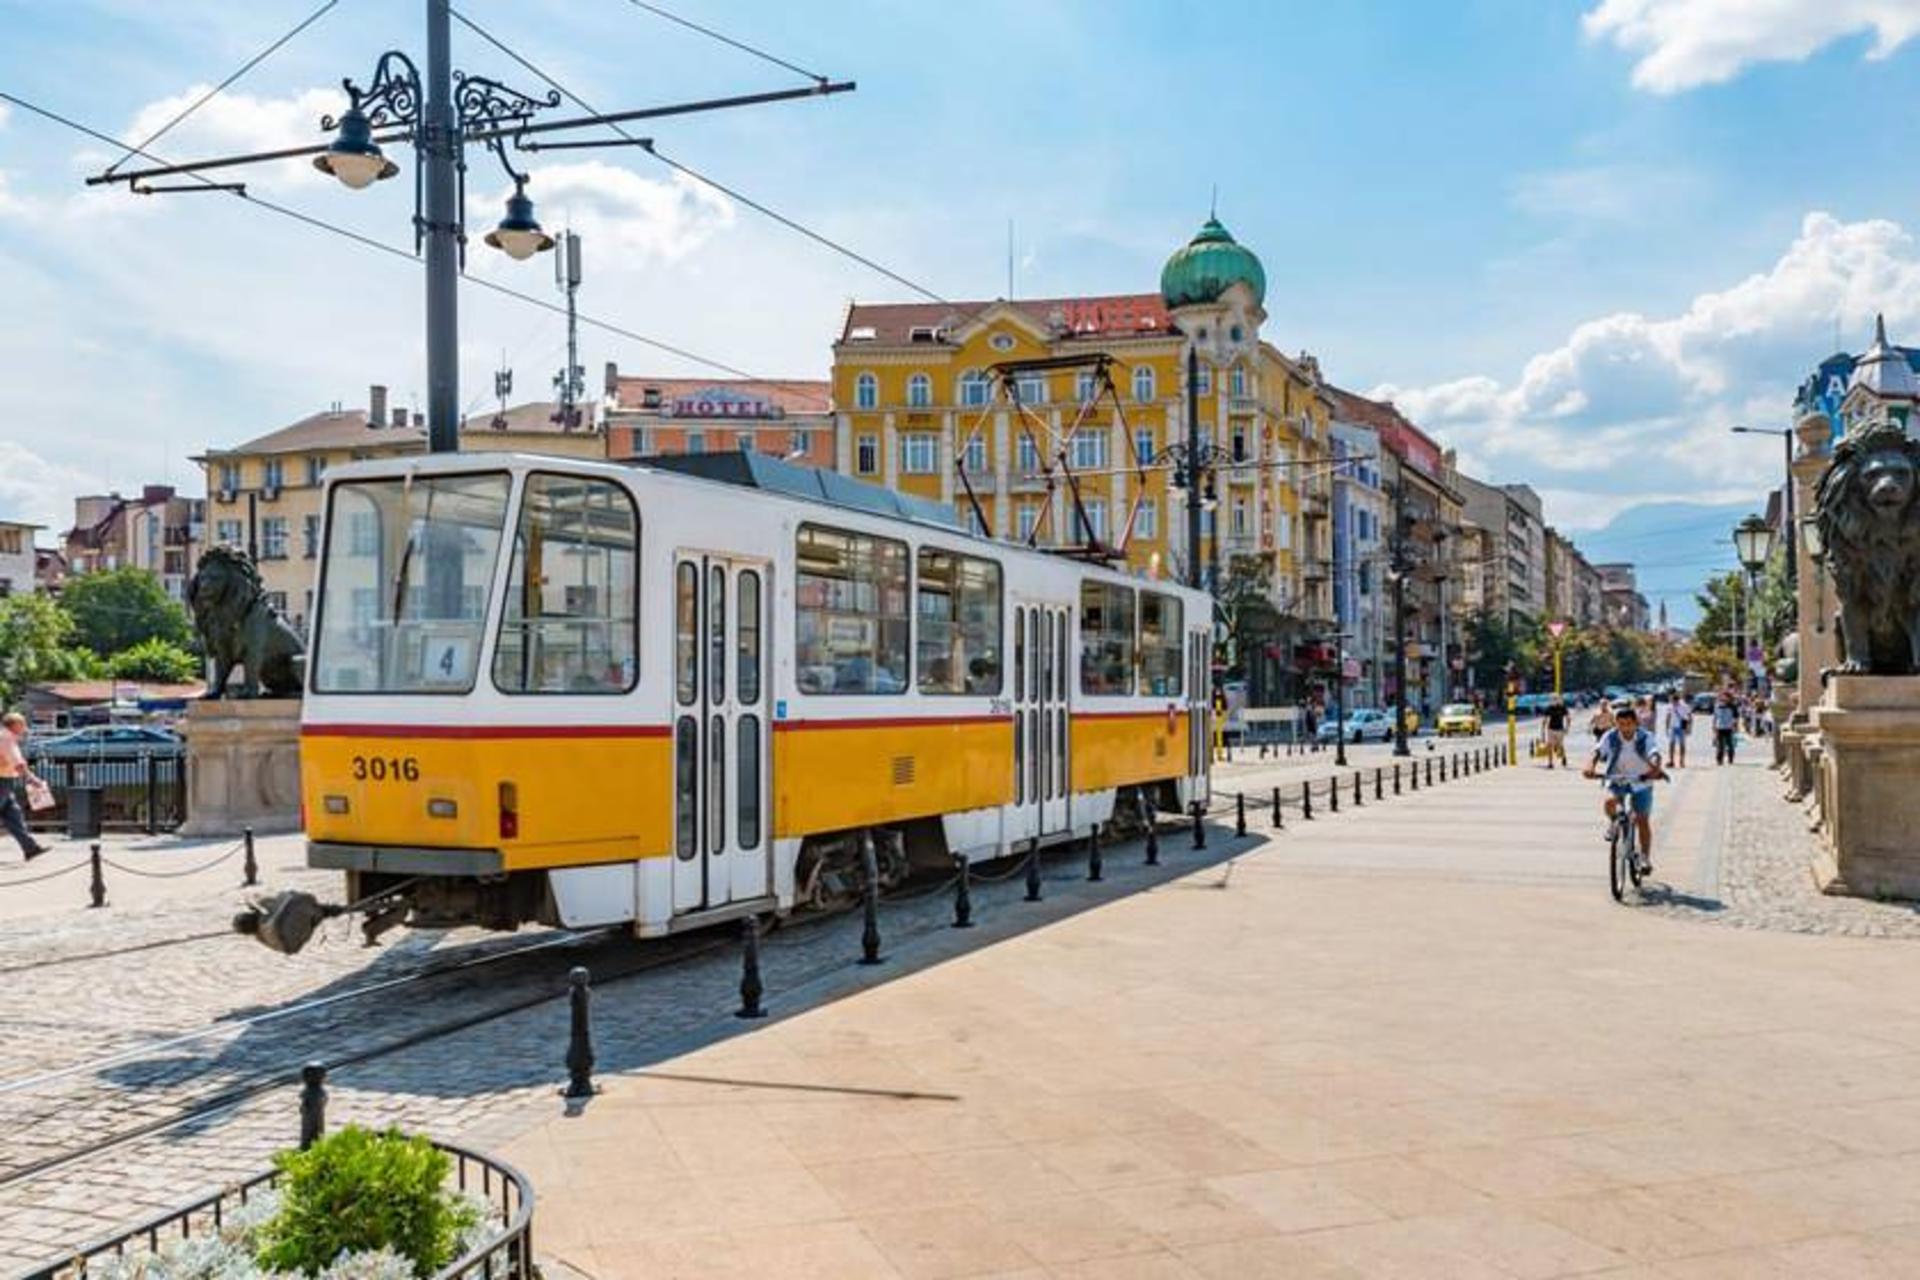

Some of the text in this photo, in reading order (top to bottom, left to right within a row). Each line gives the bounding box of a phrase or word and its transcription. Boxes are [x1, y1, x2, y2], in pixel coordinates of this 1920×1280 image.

[676, 400, 768, 416] HOTEL
[439, 645, 455, 676] 4
[352, 755, 420, 782] 3016
